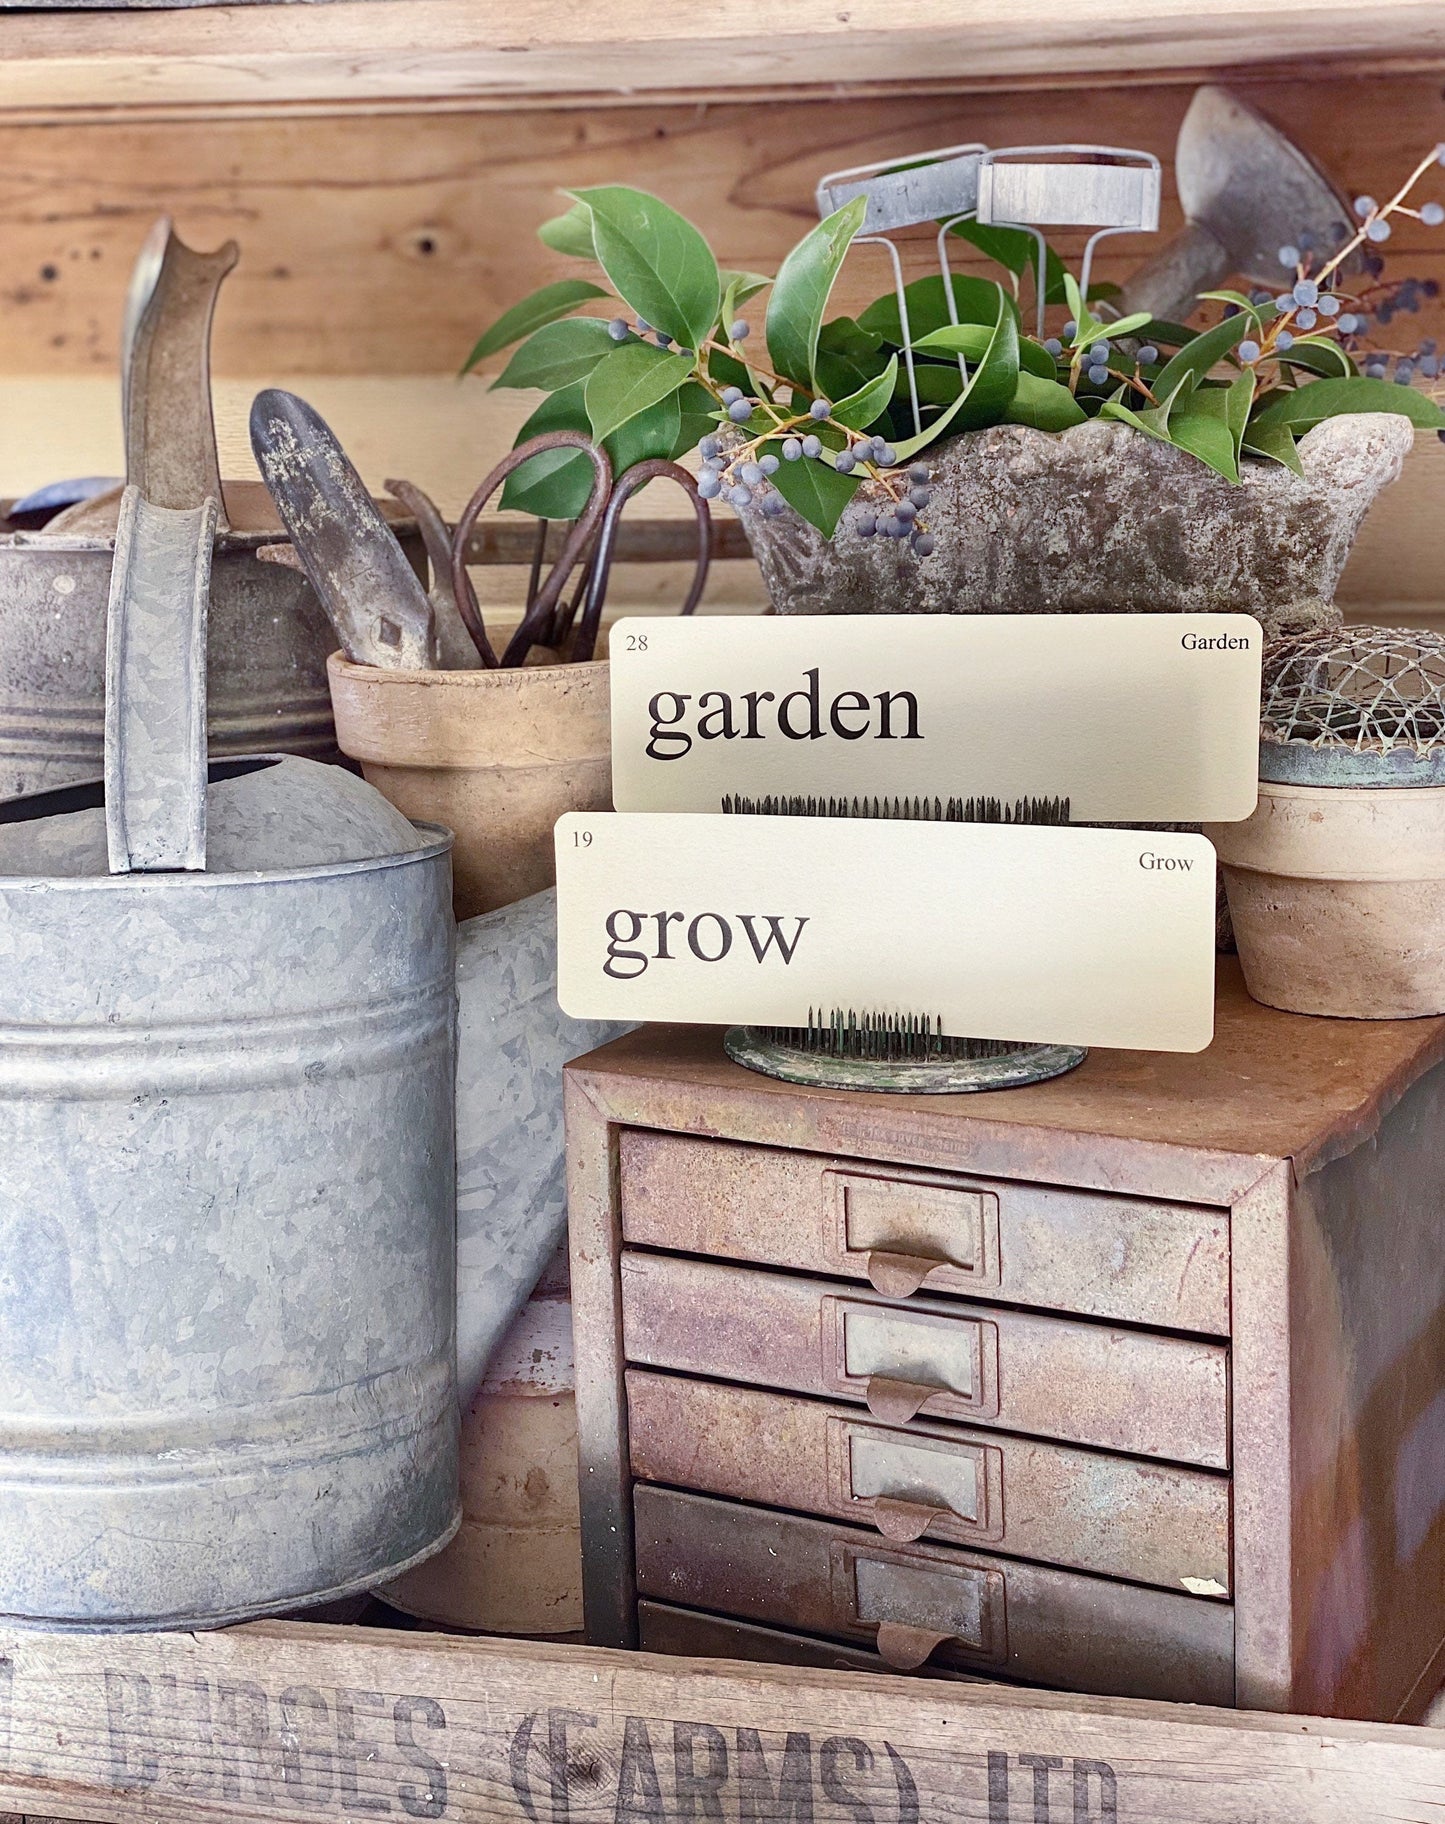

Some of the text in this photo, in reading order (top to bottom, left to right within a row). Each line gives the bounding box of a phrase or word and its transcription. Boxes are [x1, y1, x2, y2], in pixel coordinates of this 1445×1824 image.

[626, 634, 649, 652] 28
[1180, 632, 1250, 651] Garden
[645, 667, 926, 761] garden
[573, 831, 593, 848] 19
[1138, 851, 1194, 872] Grow
[602, 909, 811, 980] grow
